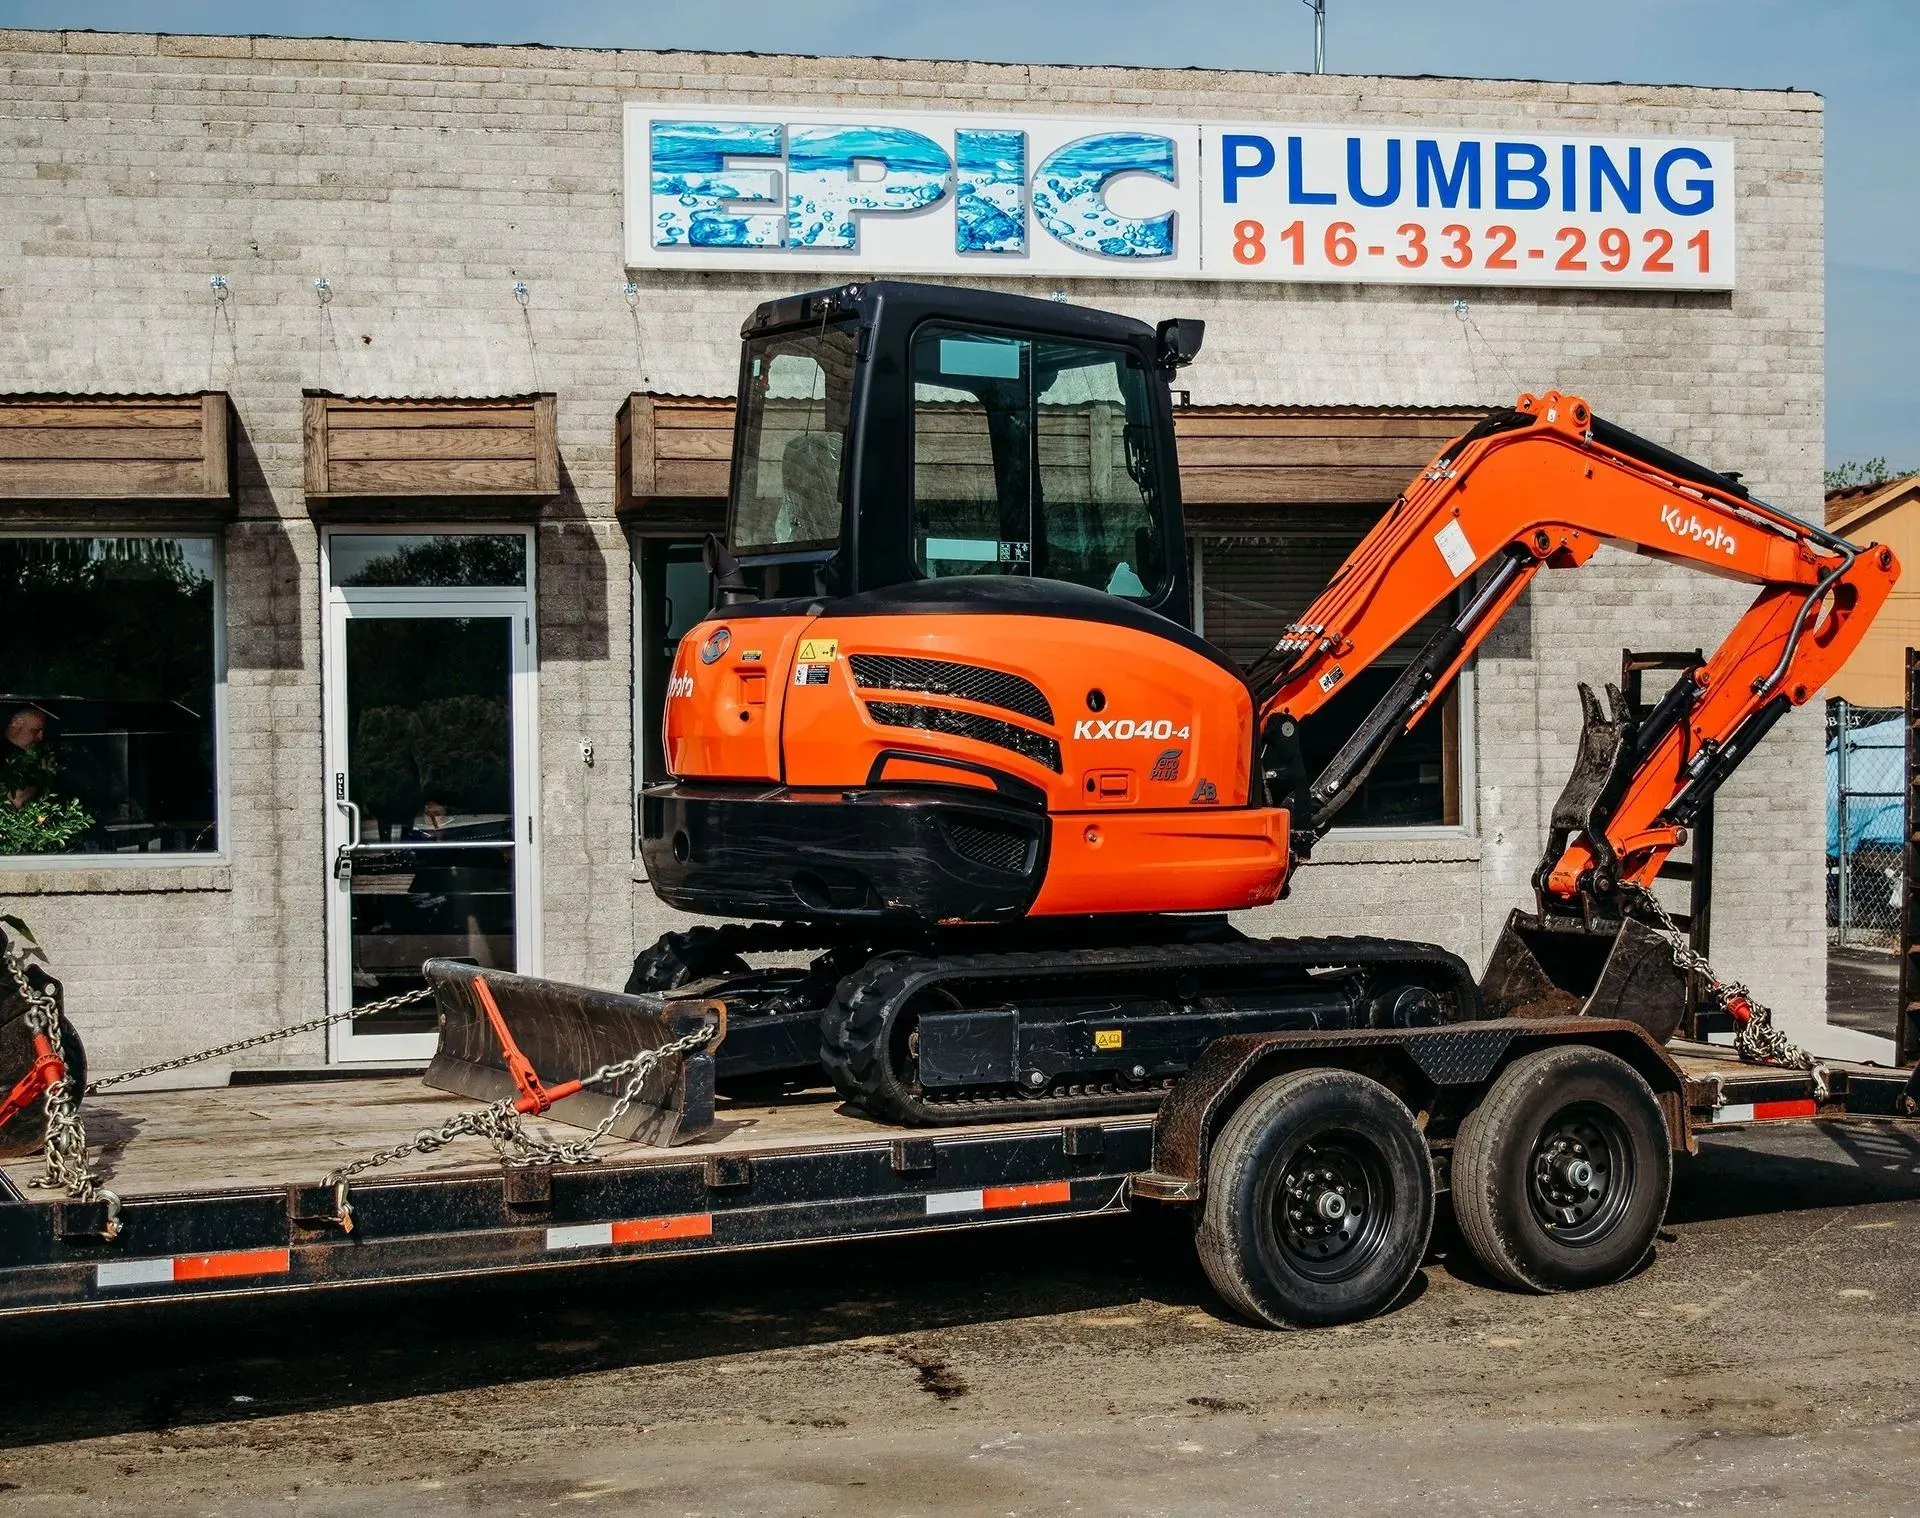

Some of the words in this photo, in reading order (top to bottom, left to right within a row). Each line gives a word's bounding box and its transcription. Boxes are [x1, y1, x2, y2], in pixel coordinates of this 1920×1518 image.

[650, 120, 1180, 261] EPIC
[1221, 133, 1715, 217] PLUMBING
[1231, 219, 1711, 273] 816-332-2921
[1660, 503, 1736, 556] Kubota
[1073, 720, 1190, 740] KX040-4
[1150, 769, 1179, 781] PLUS
[1158, 758, 1180, 770] eco
